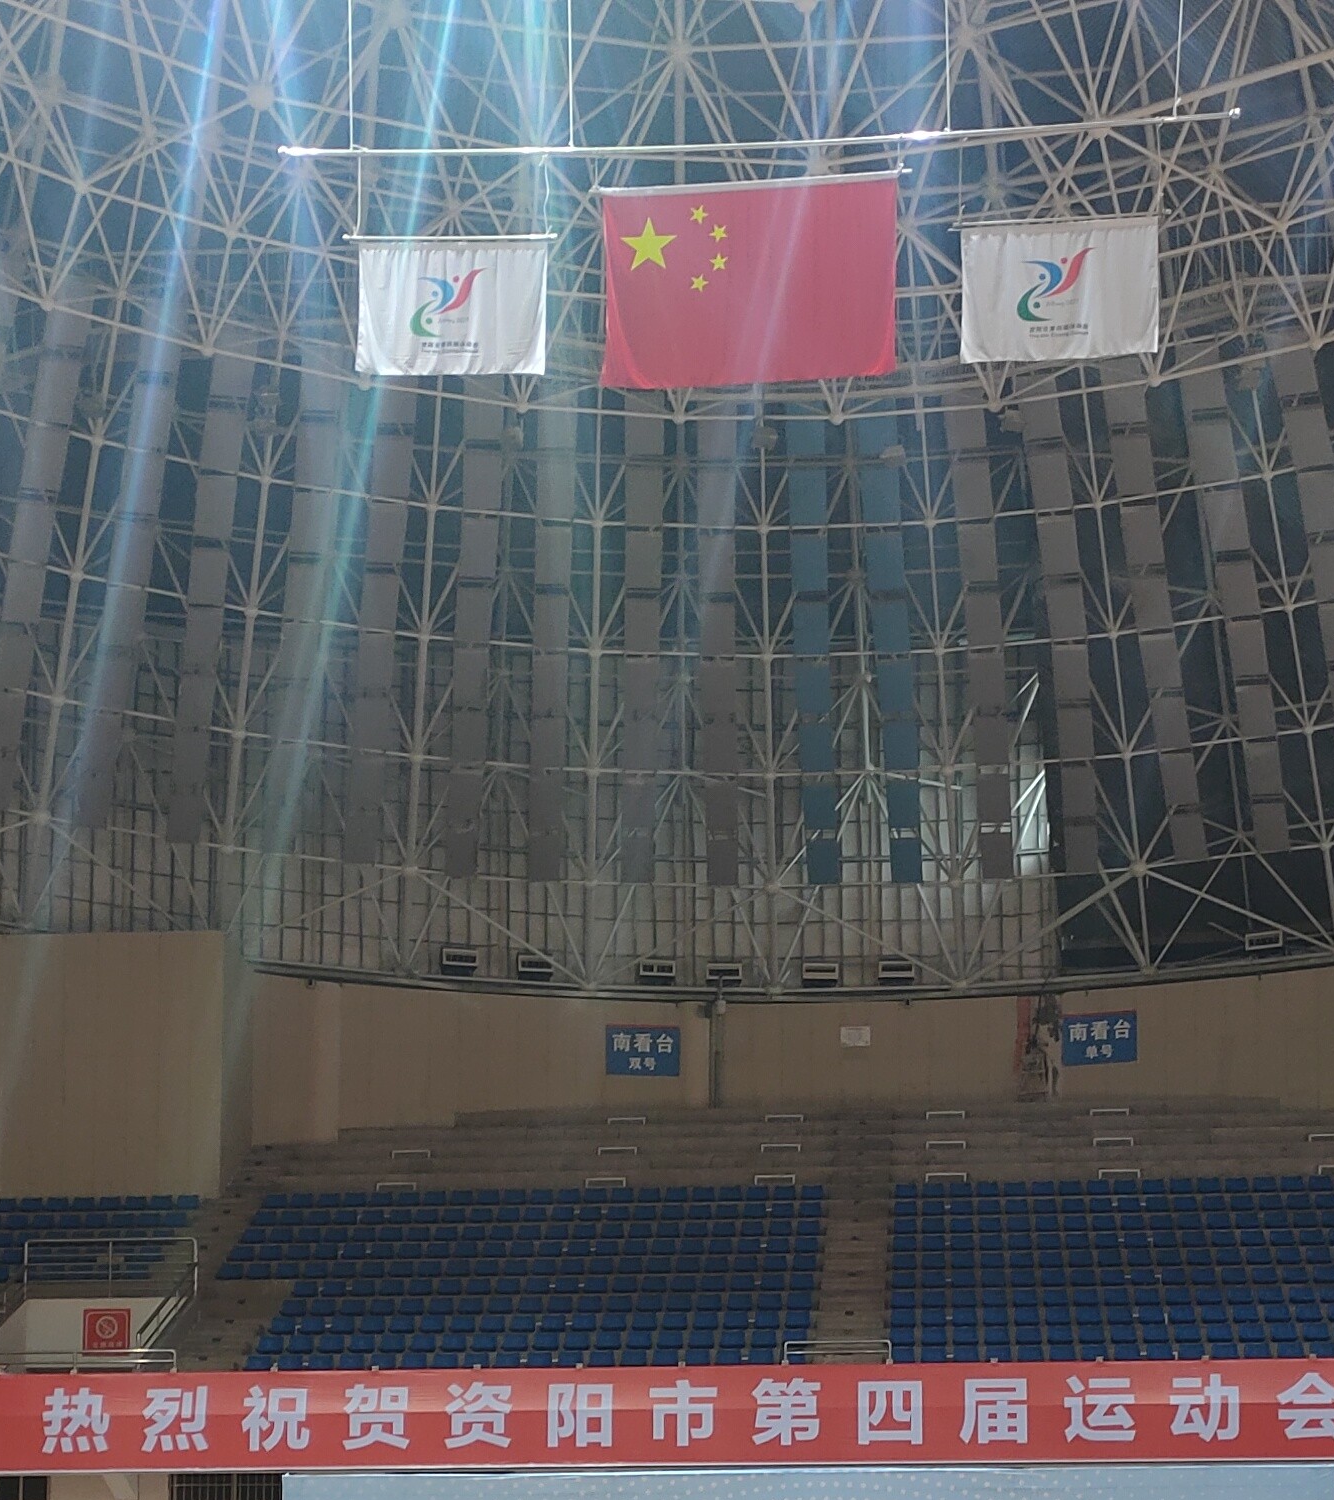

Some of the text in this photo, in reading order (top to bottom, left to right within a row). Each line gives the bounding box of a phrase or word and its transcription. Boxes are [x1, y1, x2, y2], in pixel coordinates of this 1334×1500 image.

[1068, 1019, 1131, 1042] 南看台
[612, 1032, 674, 1053] 南看台
[1085, 1044, 1114, 1059] 单号
[629, 1057, 656, 1071] 双号
